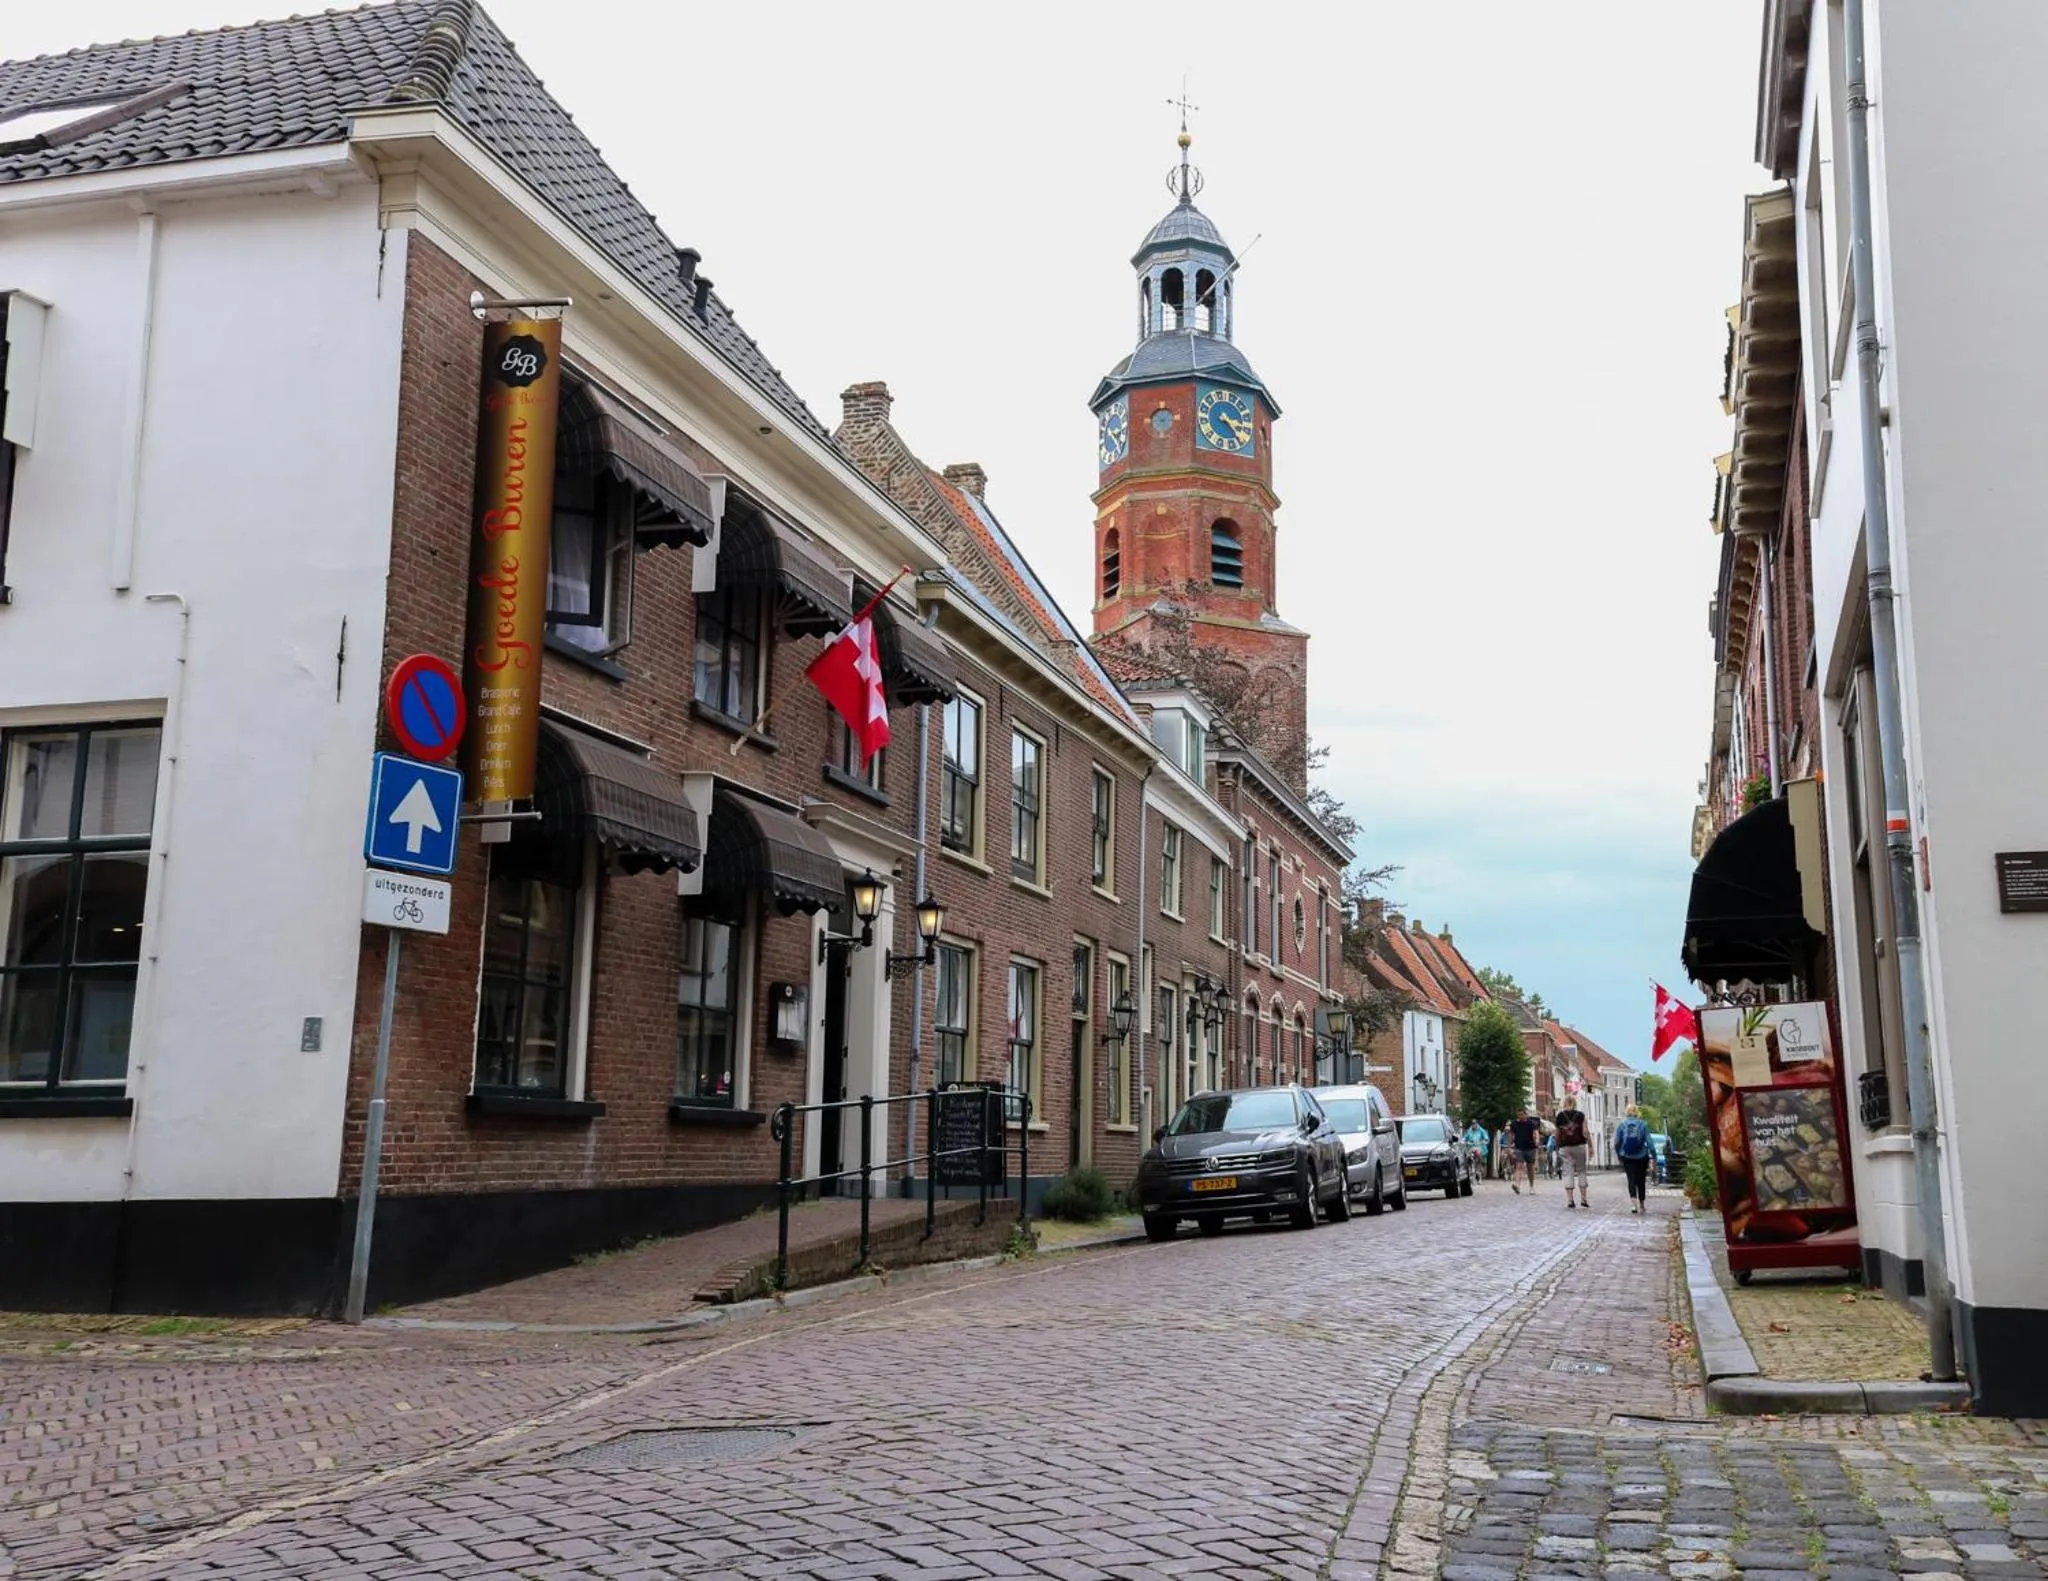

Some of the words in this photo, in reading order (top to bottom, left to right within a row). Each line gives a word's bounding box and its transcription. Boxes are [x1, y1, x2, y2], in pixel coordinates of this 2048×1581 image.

[501, 347, 537, 376] GB
[482, 417, 528, 540] Buren
[473, 555, 532, 673] Goede
[375, 879, 445, 899] uitgezonderd
[1752, 1114, 1798, 1126] Kwaliteit
